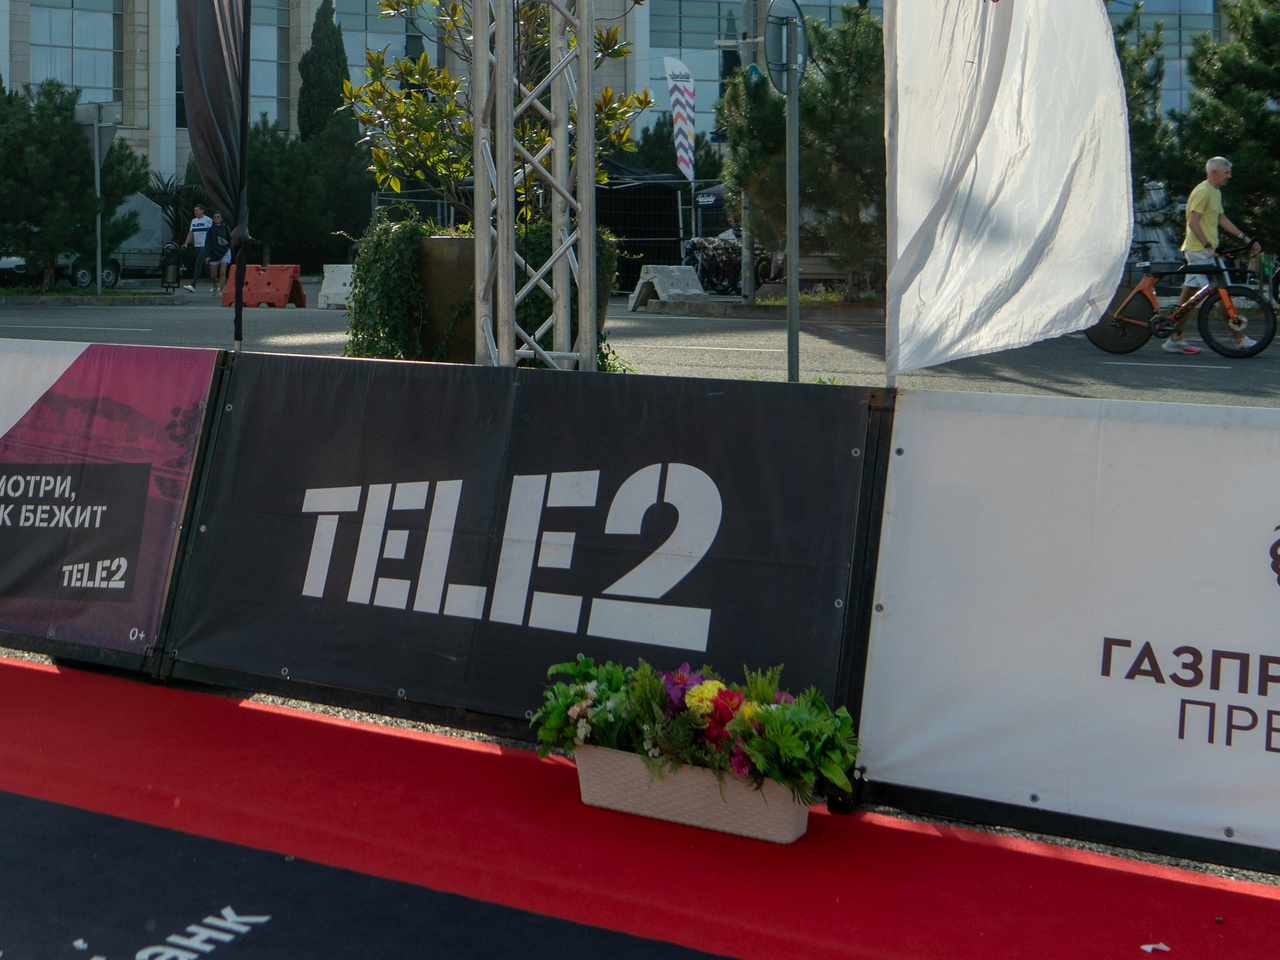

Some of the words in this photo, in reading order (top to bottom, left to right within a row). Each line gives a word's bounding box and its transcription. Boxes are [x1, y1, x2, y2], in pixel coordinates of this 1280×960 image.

[18, 504, 108, 529] БЕЖИТ
[301, 462, 723, 653] TELE2
[62, 556, 129, 589] TELE2
[128, 627, 146, 642] 0+
